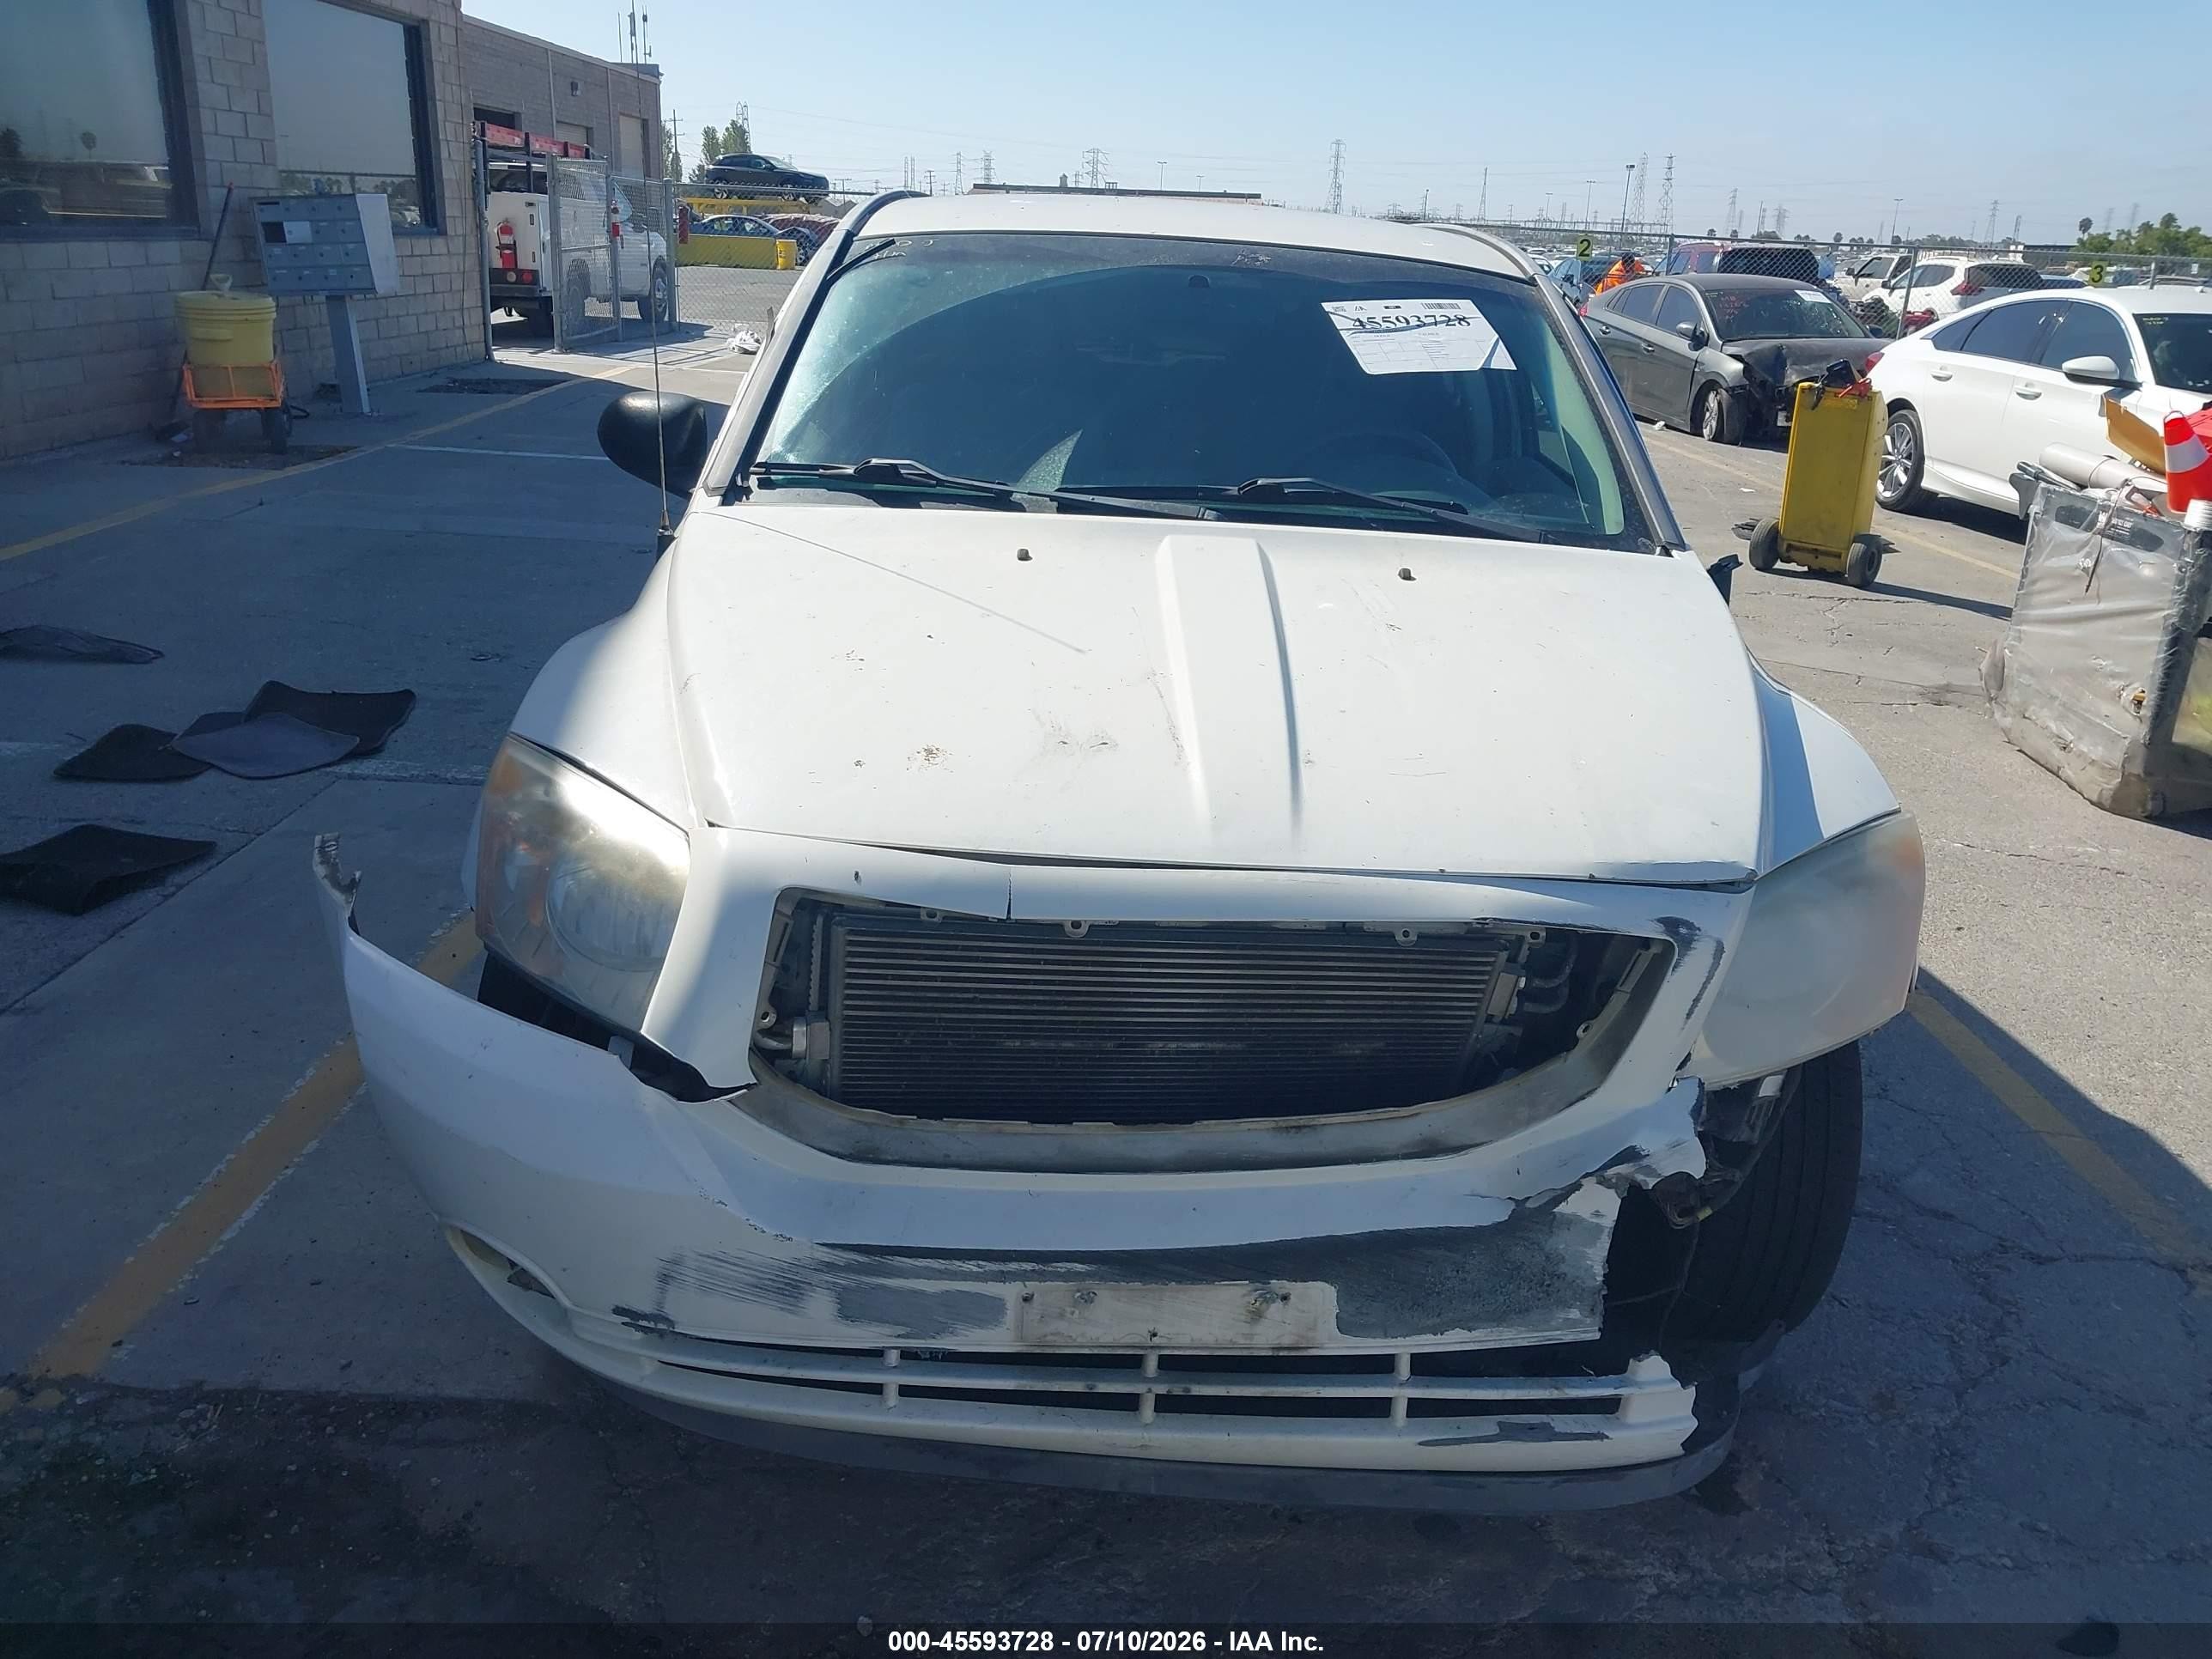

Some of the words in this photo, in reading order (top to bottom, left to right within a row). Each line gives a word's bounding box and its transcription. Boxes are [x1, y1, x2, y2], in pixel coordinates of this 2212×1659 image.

[1578, 239, 1591, 257] 2
[2092, 264, 2104, 283] 3
[1352, 314, 1471, 329] 45593728
